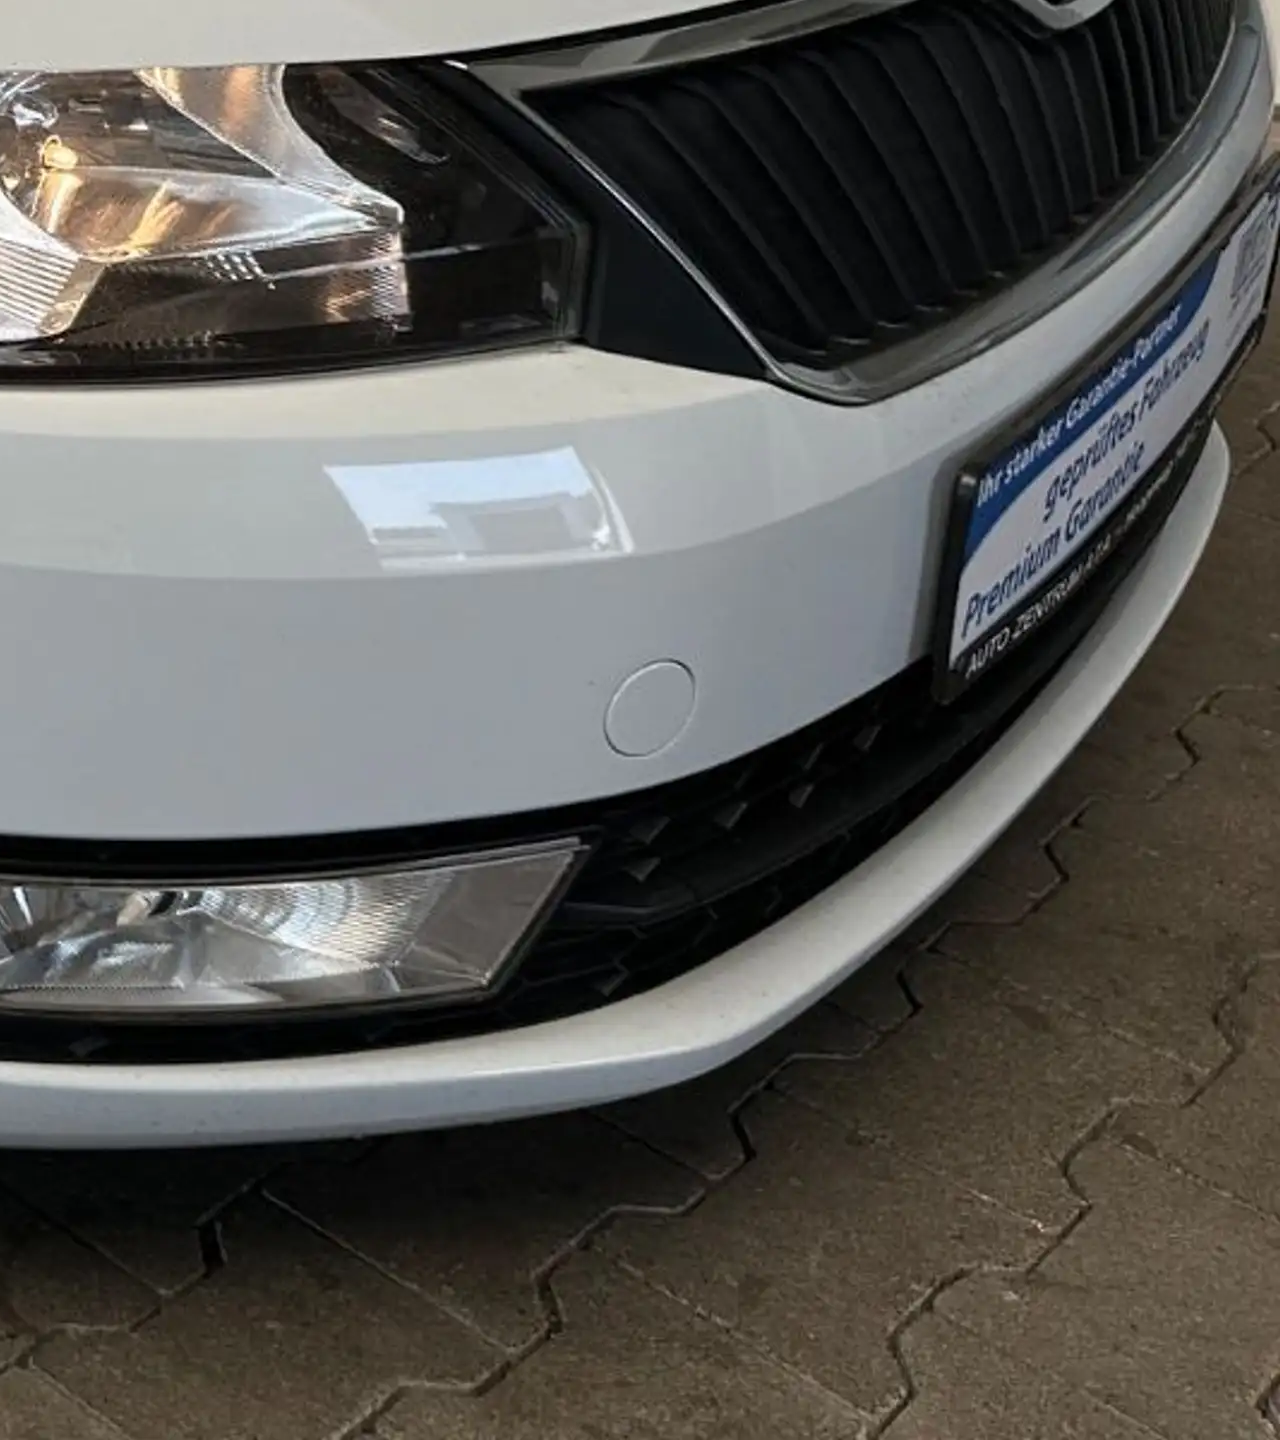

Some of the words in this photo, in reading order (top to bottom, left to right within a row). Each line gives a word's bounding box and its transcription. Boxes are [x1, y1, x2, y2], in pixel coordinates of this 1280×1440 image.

[976, 472, 1001, 508] Ihr
[1003, 422, 1064, 484] starker
[1043, 398, 1138, 523] geprüftes
[961, 526, 1062, 640] Premium
[1064, 440, 1146, 544] Garantie
[965, 628, 1010, 680] AUTO
